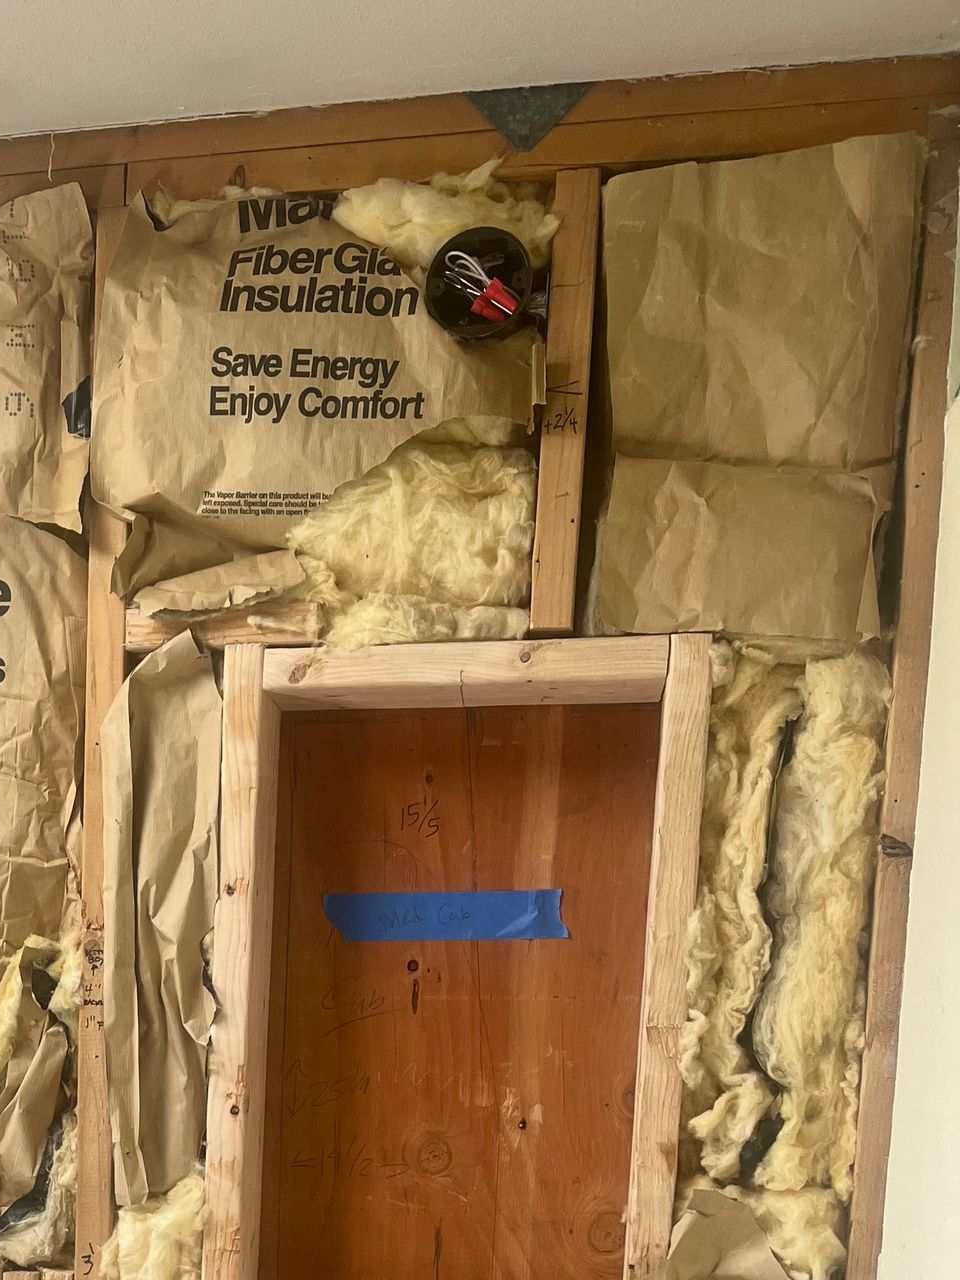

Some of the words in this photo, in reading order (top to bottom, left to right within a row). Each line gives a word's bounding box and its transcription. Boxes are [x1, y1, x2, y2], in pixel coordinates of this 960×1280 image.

[227, 242, 402, 279] FiberGla
[219, 277, 419, 318] Insulation
[211, 347, 282, 378] Save
[290, 348, 400, 389] Energy
[209, 386, 290, 424] Enjoy
[297, 387, 425, 421] Comfort
[213, 500, 241, 508] exposed.
[244, 500, 267, 508] Special
[217, 491, 235, 500] Vapor
[236, 491, 257, 499] Barrier
[283, 492, 308, 501] product
[240, 508, 259, 516] facing
[438, 903, 471, 926] Cab
